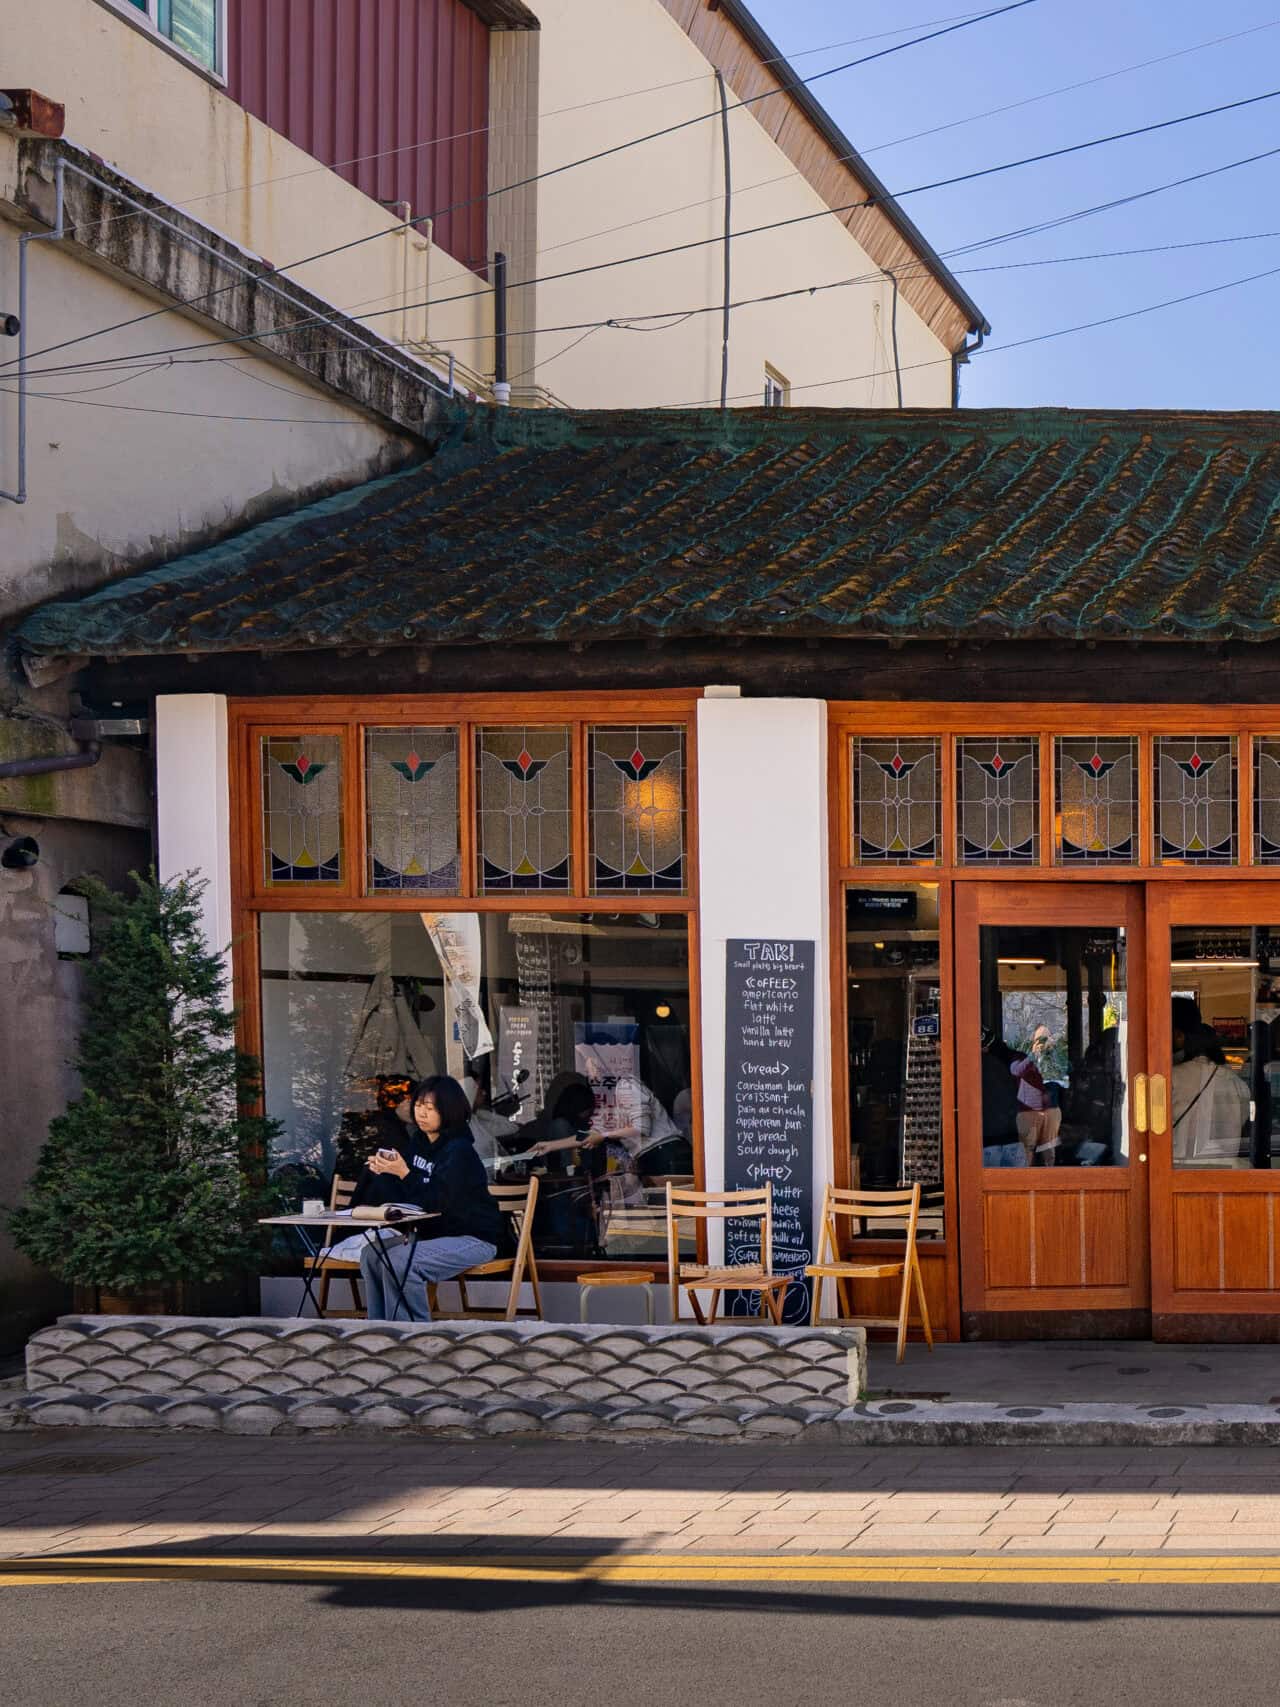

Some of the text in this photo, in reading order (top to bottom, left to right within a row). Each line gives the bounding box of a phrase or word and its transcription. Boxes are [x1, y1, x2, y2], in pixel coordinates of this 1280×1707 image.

[752, 1012, 776, 1025] latte
[774, 1025, 794, 1037] latte
[787, 1079, 805, 1092] bun
[784, 1117, 802, 1130] bun
[737, 1130, 787, 1145] rye bread
[767, 1144, 799, 1162] dough
[772, 1183, 803, 1198] butter
[771, 1202, 800, 1217] heese
